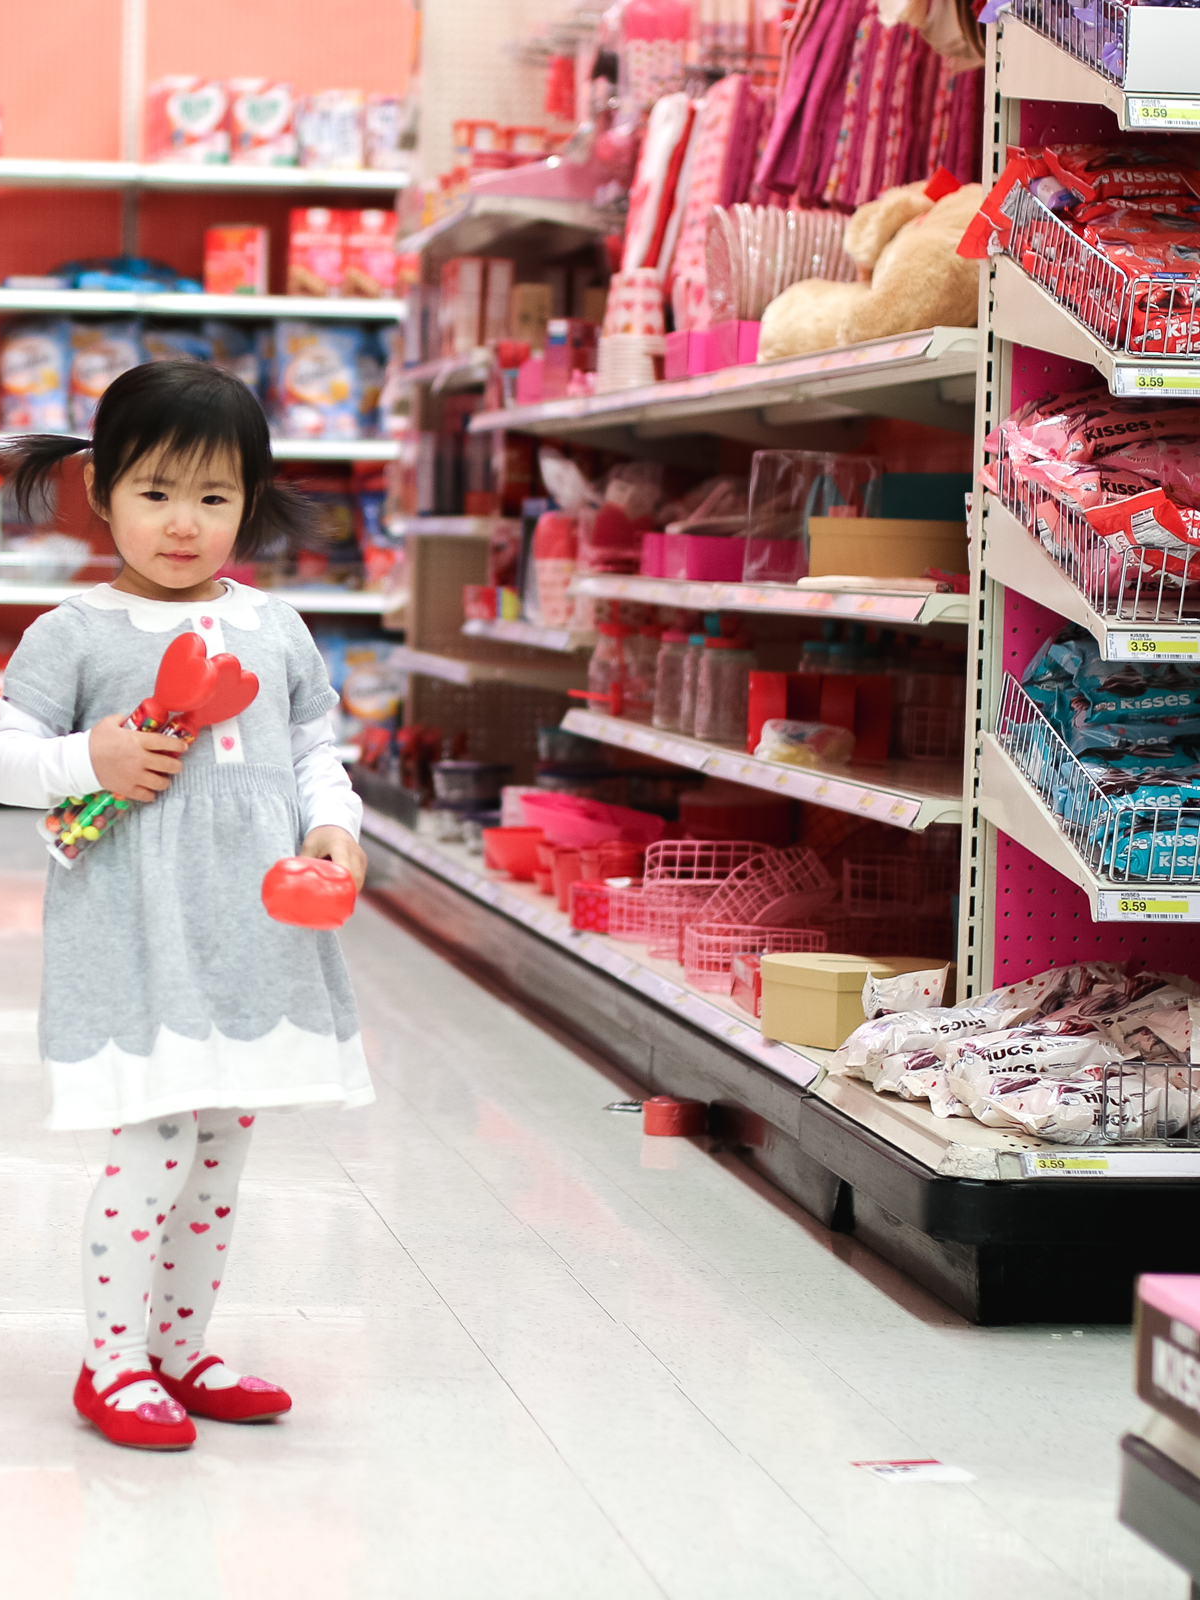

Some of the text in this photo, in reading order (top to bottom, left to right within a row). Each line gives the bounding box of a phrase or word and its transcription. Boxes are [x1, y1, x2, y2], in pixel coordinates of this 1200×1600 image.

[1142, 108, 1167, 118] 3.59
[1139, 376, 1164, 387] 3.59
[1131, 642, 1156, 651] 3.59
[1121, 694, 1191, 709] KISSES
[1121, 901, 1146, 911] 3.59
[1039, 1160, 1065, 1168] 3.59
